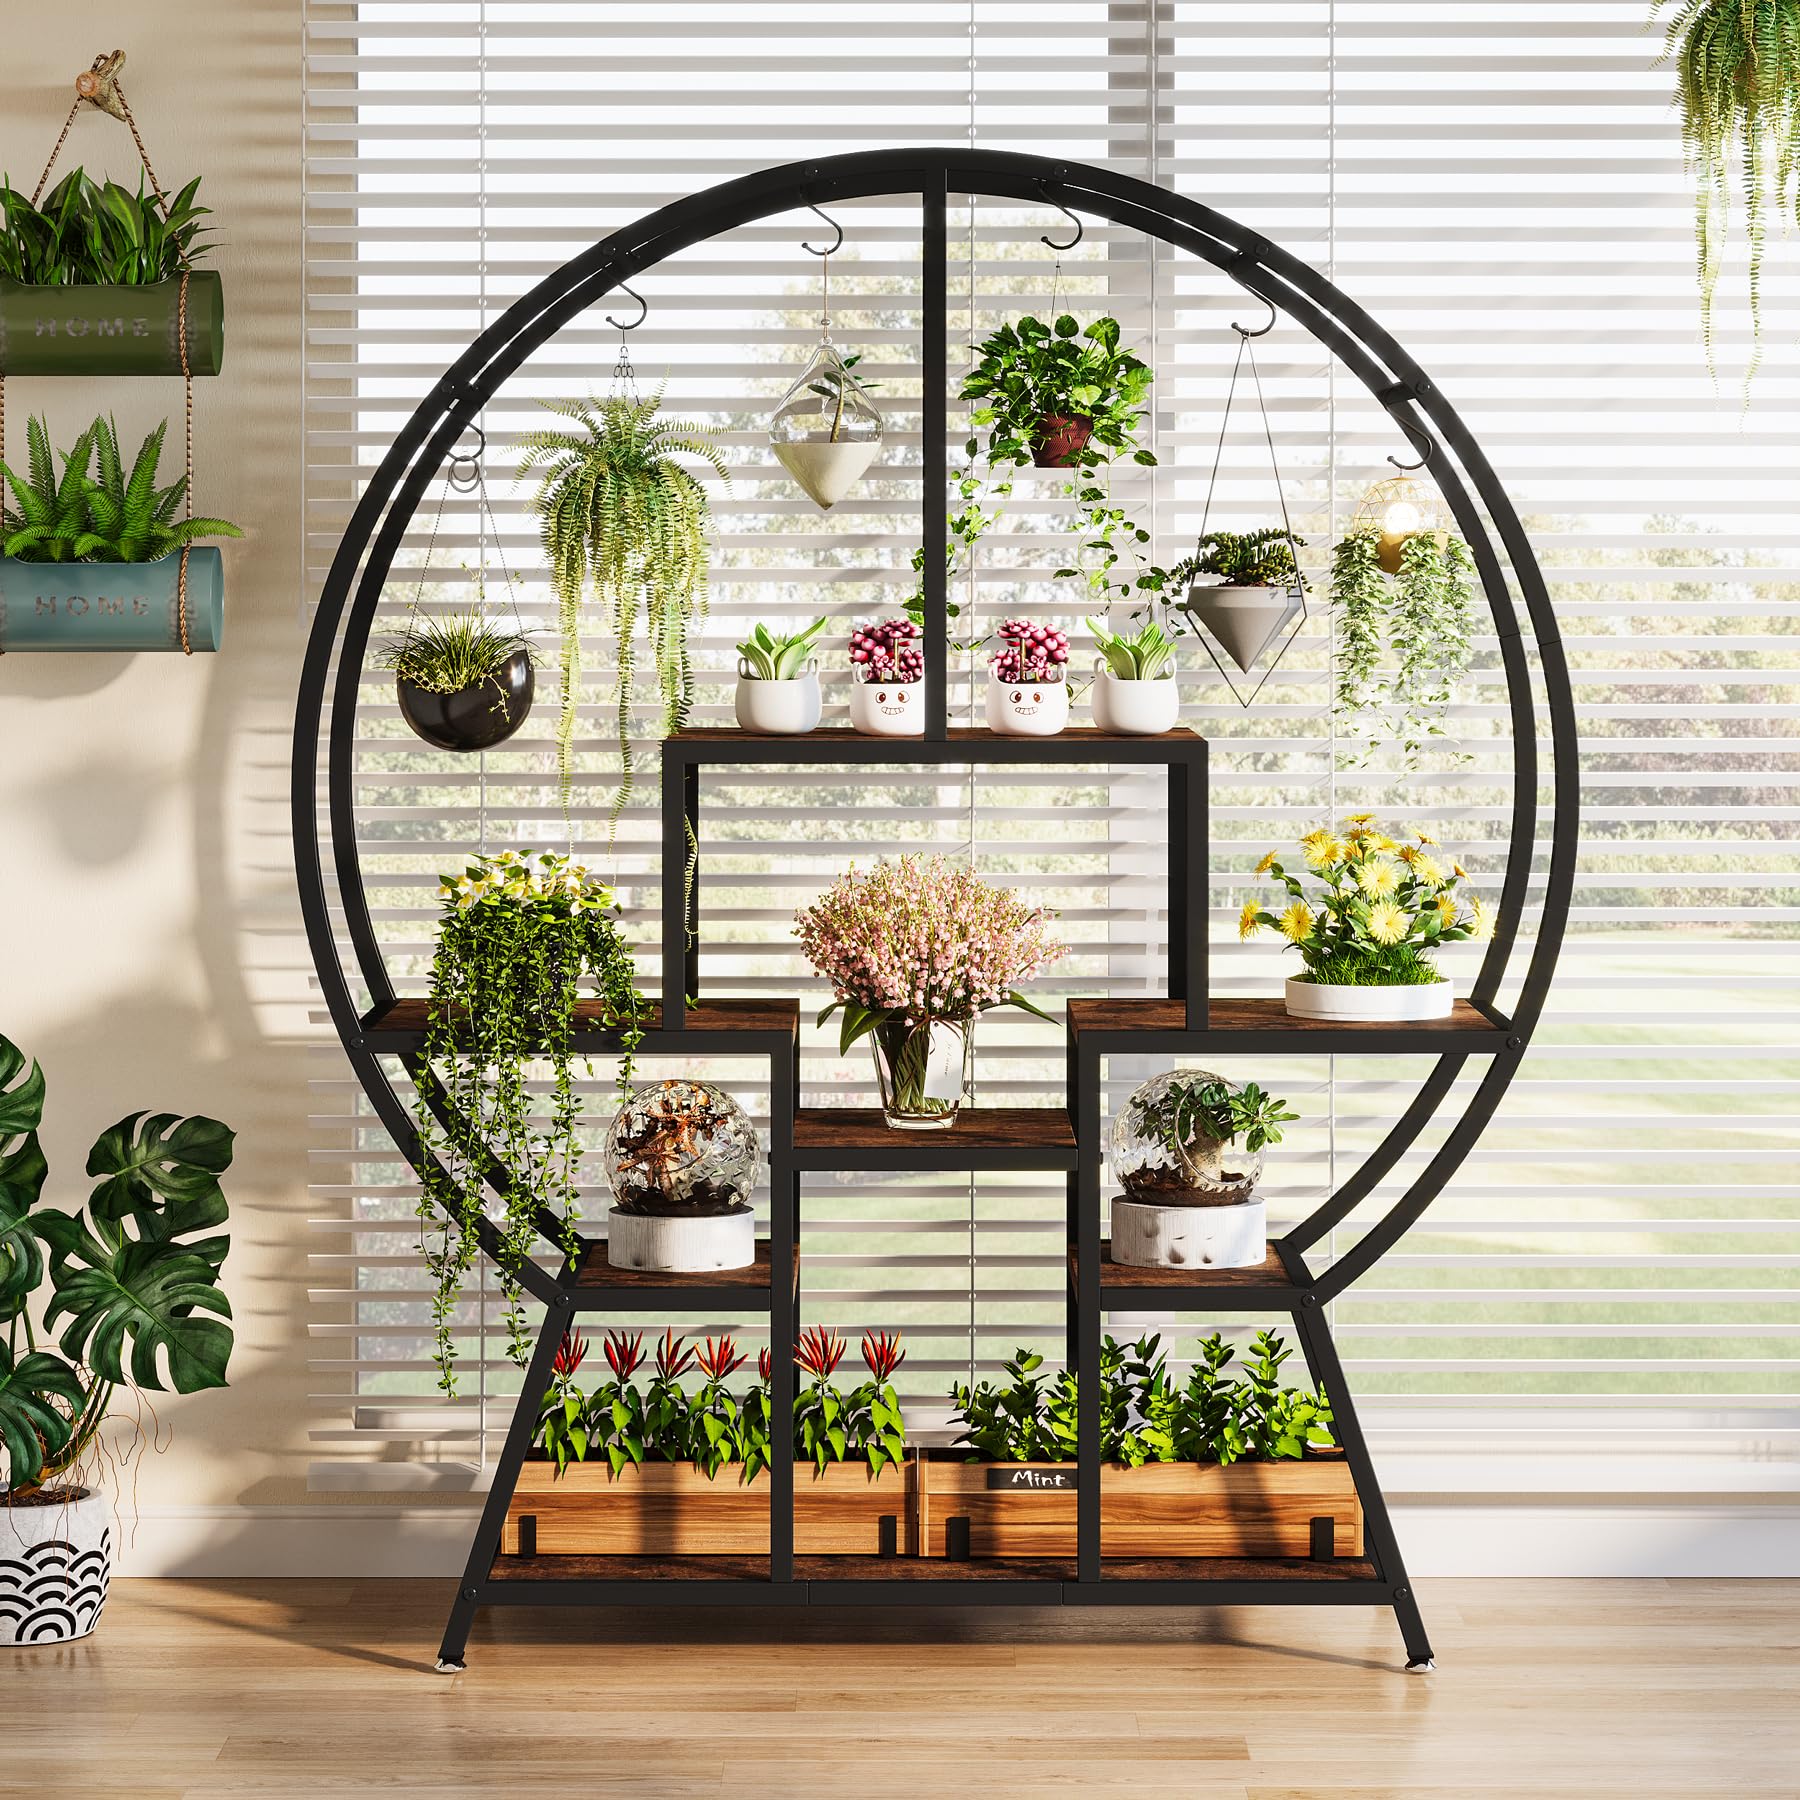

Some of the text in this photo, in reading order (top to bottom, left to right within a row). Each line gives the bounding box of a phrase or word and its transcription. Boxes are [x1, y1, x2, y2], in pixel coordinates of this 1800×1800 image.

[35, 317, 150, 337] HOME
[35, 595, 150, 616] HOME
[1011, 1470, 1066, 1487] Mint
